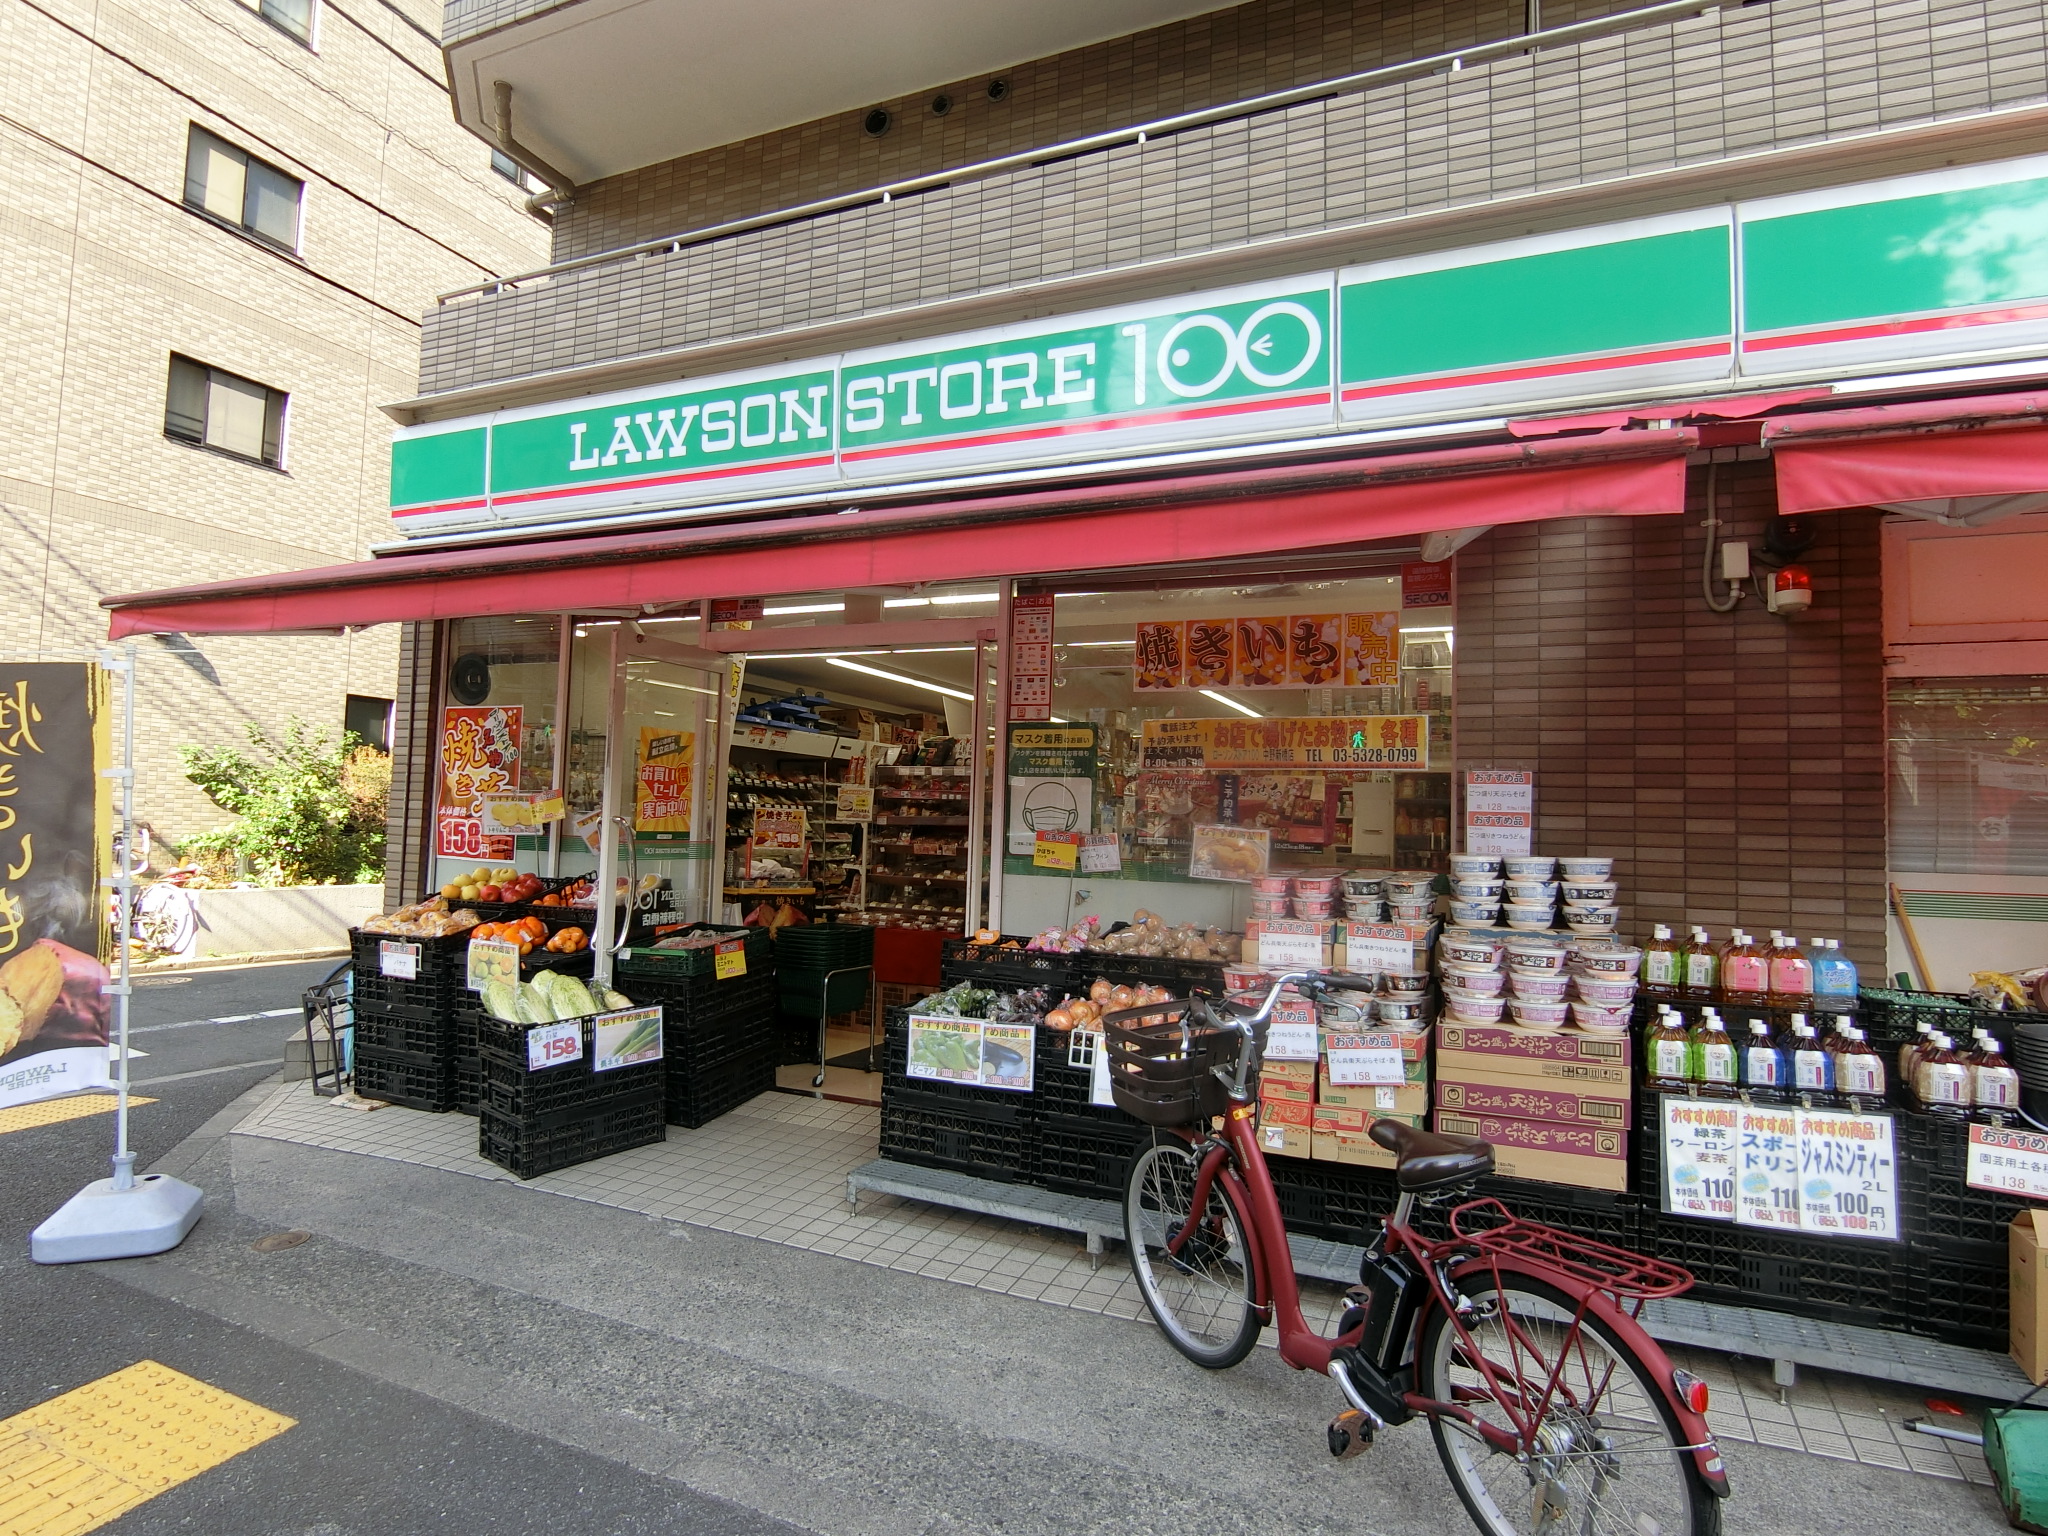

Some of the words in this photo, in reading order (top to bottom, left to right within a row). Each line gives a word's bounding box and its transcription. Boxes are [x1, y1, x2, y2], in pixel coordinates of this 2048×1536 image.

[569, 385, 828, 471] LAWSON
[845, 342, 1096, 433] STORE
[1122, 301, 1322, 406] 100
[1405, 592, 1449, 605] SECOM
[712, 611, 737, 620] SECOM
[1138, 621, 1338, 672] 焼きいも
[1347, 613, 1398, 685] 販売中
[1159, 720, 1198, 734] 電話注文
[895, 733, 917, 745] おでん
[1014, 733, 1090, 745] マスク着用のお願い
[1380, 718, 1419, 749] 各種
[1305, 748, 1323, 762] TEL
[1332, 748, 1417, 763] 03-5328-0799
[1148, 776, 1173, 786] Merry
[1474, 773, 1525, 783] おすすめ品
[653, 782, 680, 797] セール
[1468, 790, 1527, 798] ごつ盛り天ぷらそば
[1487, 802, 1503, 811] 128
[766, 811, 793, 820] 焼き芋
[1474, 815, 1525, 826] おすすめ品
[441, 820, 482, 854] 158
[776, 833, 799, 843] 158
[1468, 832, 1526, 840] ごつ盛りきつねうどん
[1036, 847, 1056, 855] かぼちゃ
[1486, 845, 1502, 853] 128
[1266, 923, 1315, 934] おすすめ品
[1354, 925, 1406, 939] おすすめ品
[1278, 953, 1294, 962] 158
[1367, 957, 1383, 966] 158
[915, 1020, 978, 1034] おすすめ商品！
[1334, 1035, 1392, 1047] おすすめ品
[543, 1036, 577, 1061] 158
[1269, 1045, 1287, 1055] 158
[912, 1064, 935, 1075] ピーマン
[1352, 1071, 1371, 1081] 158
[1693, 1127, 1727, 1139] 緑茶
[1802, 1117, 1885, 1141] おすすめ商品！
[1670, 1138, 1735, 1151] ウーロン
[1981, 1128, 2048, 1151] おすすめ
[1695, 1152, 1729, 1164] 麦茶
[1801, 1138, 1890, 1179] ジャスミンティー
[1675, 1187, 1699, 1198] 本体価格
[1702, 1177, 1734, 1199] 110
[1861, 1179, 1889, 1193] 2L
[2001, 1175, 2026, 1189] 138
[1708, 1199, 1734, 1213] 119
[1742, 1196, 1767, 1208] 本体価格
[1805, 1203, 1831, 1214] 本体価格
[1833, 1191, 1869, 1215] 100
[1871, 1205, 1885, 1218] 円
[1840, 1215, 1868, 1230] 108
